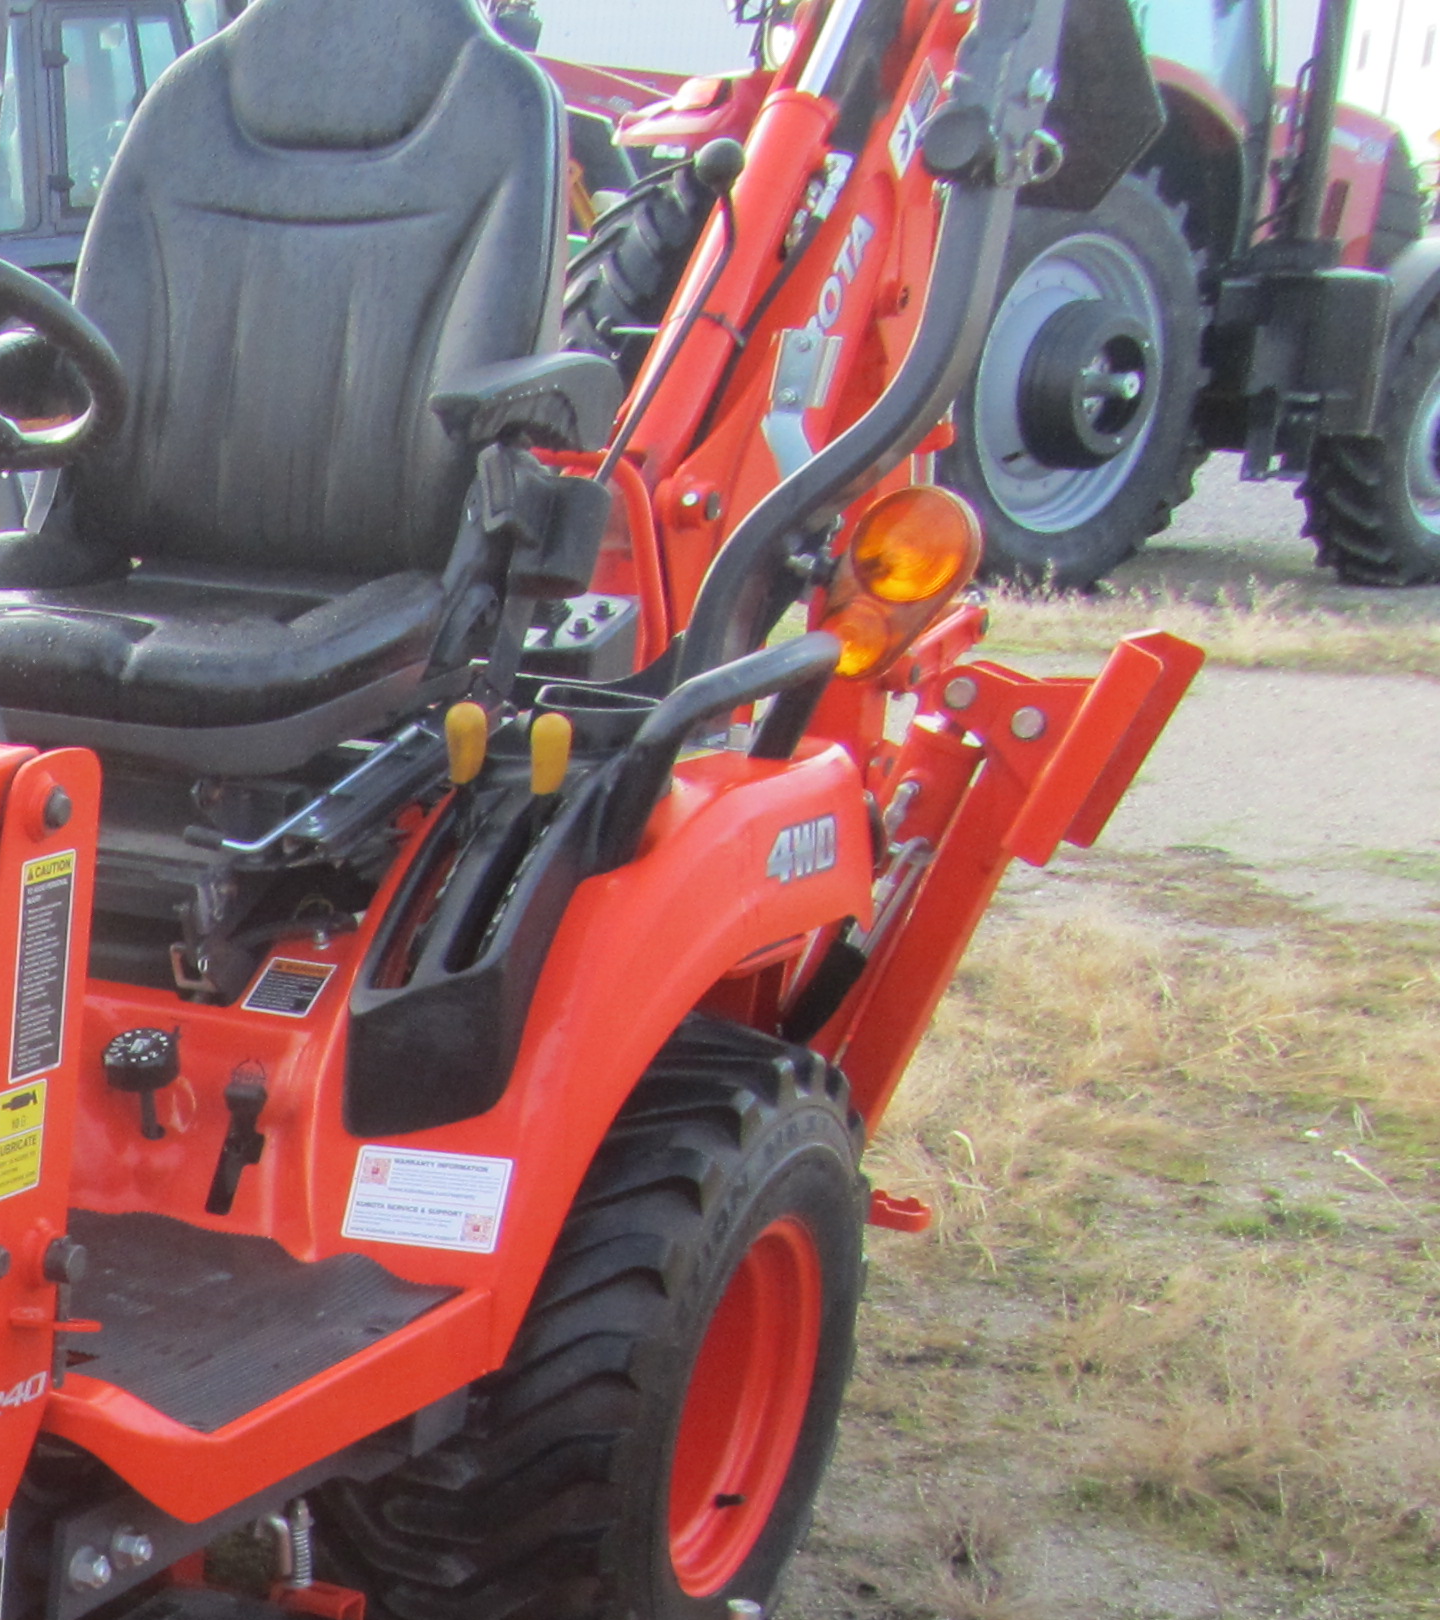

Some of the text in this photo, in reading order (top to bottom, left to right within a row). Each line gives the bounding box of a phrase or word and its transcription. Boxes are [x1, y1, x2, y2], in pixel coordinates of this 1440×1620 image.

[766, 813, 837, 884] 4WD
[34, 858, 72, 878] CAUTION
[394, 1157, 489, 1173] WARRANTY INFORMATION
[386, 1203, 420, 1213] SERVICE
[428, 1208, 464, 1218] SUPPORT
